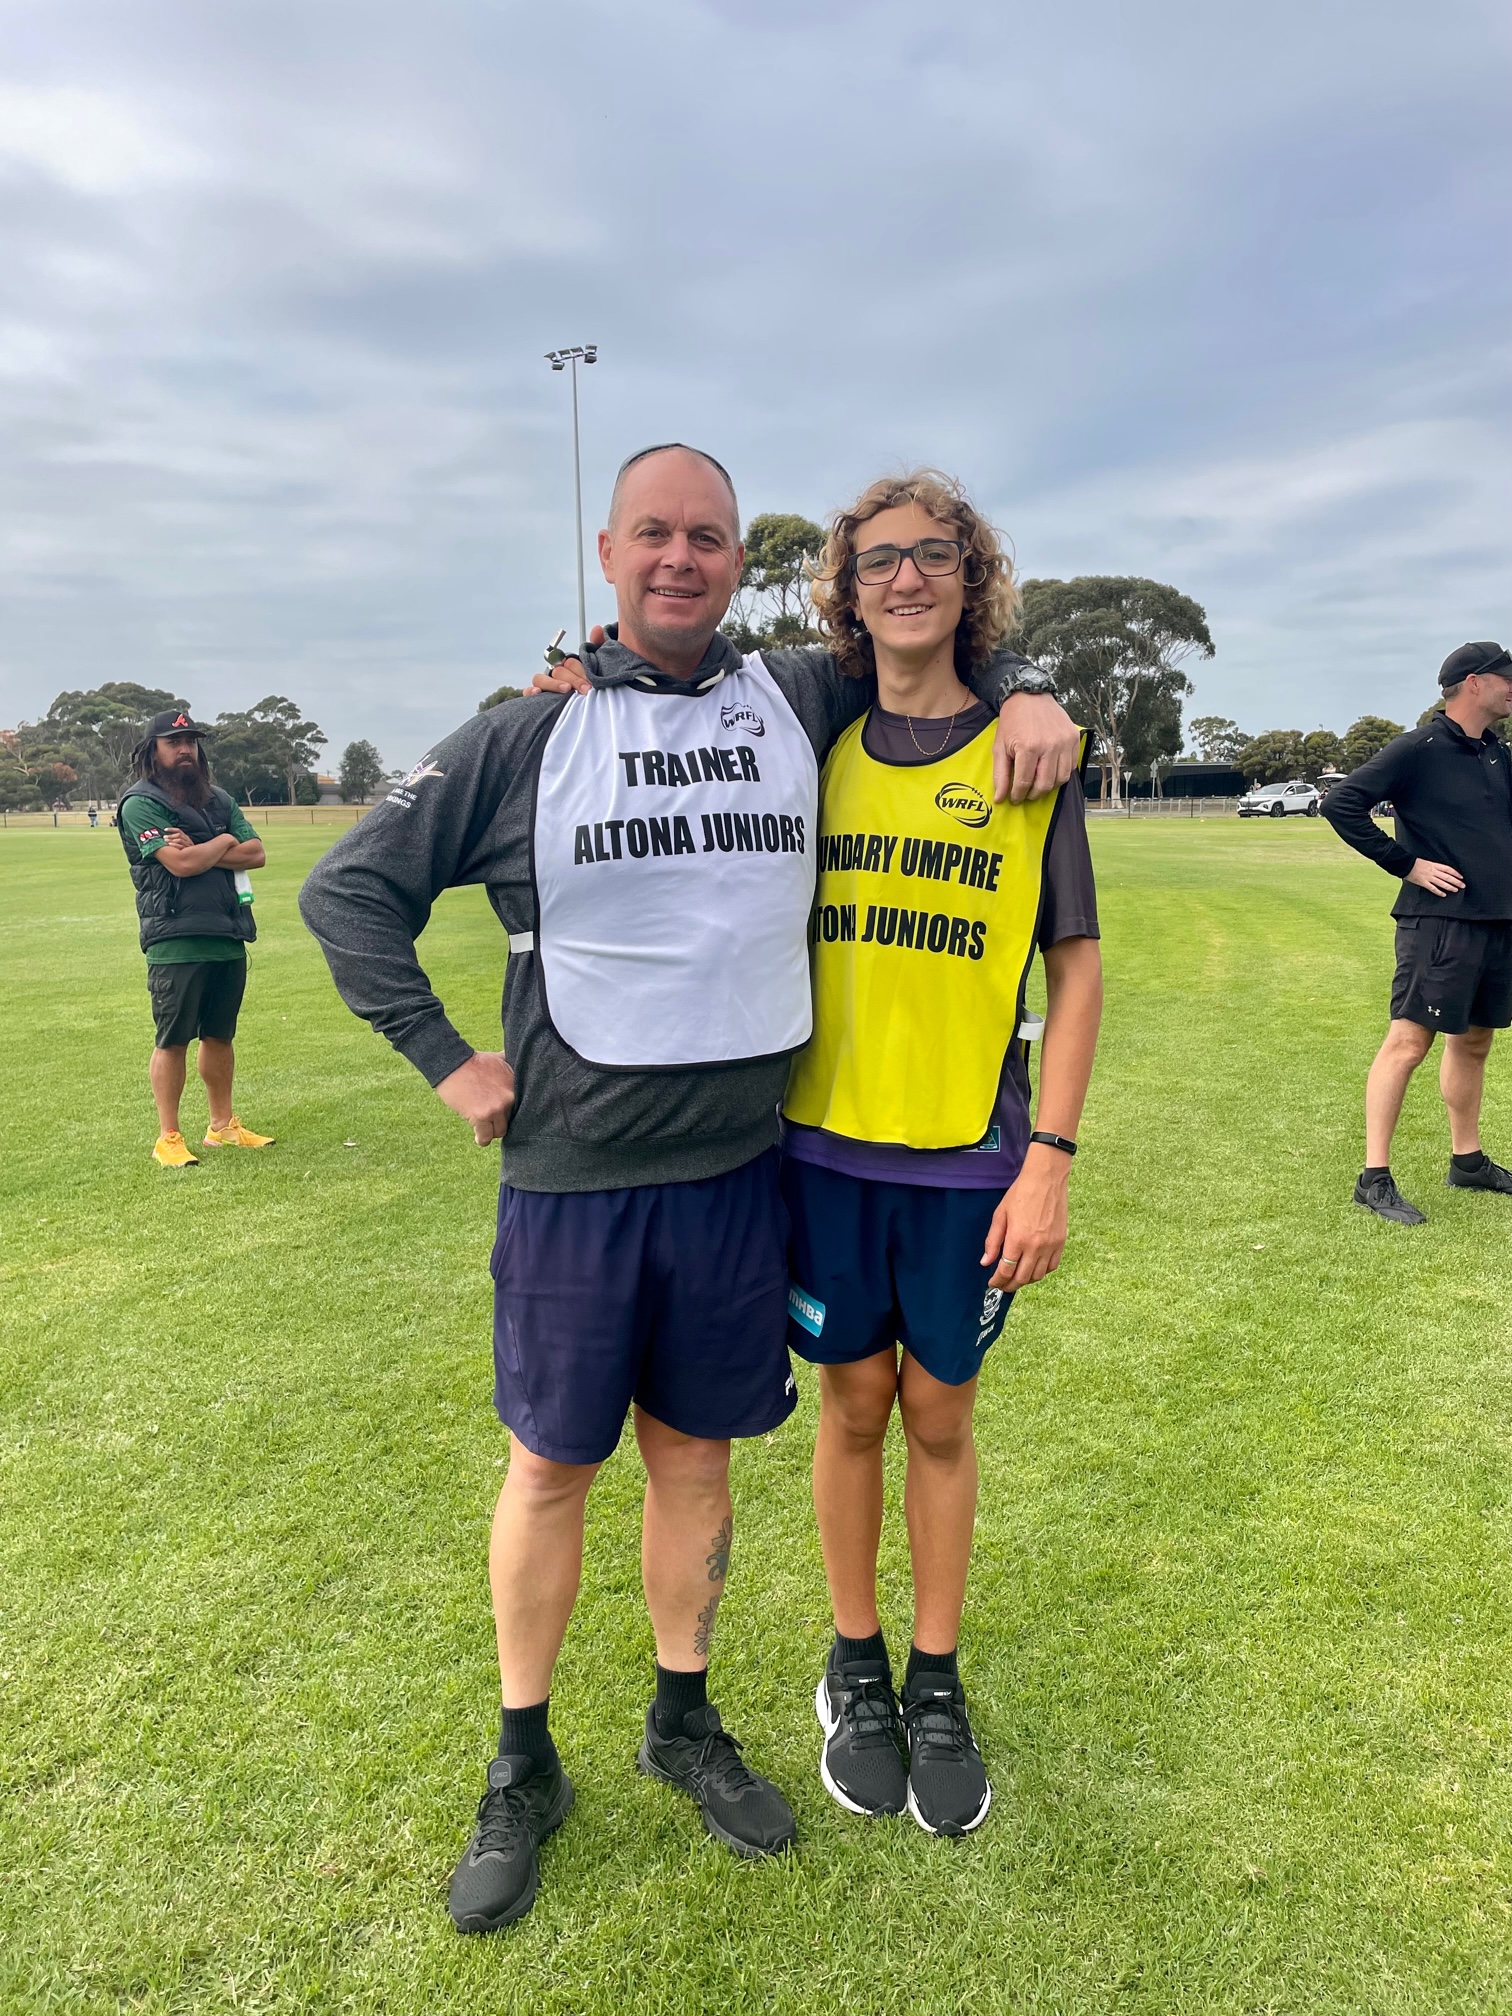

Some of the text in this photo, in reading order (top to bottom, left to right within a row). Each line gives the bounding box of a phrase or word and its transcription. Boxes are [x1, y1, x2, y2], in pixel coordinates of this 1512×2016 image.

[723, 711, 758, 728] WRFL
[618, 745, 761, 788] TRAINER
[941, 797, 986, 812] WRFL
[574, 812, 805, 865] ALTONA JUNIORS
[900, 837, 1004, 892] UMPIRE
[861, 905, 987, 961] JUNIORS
